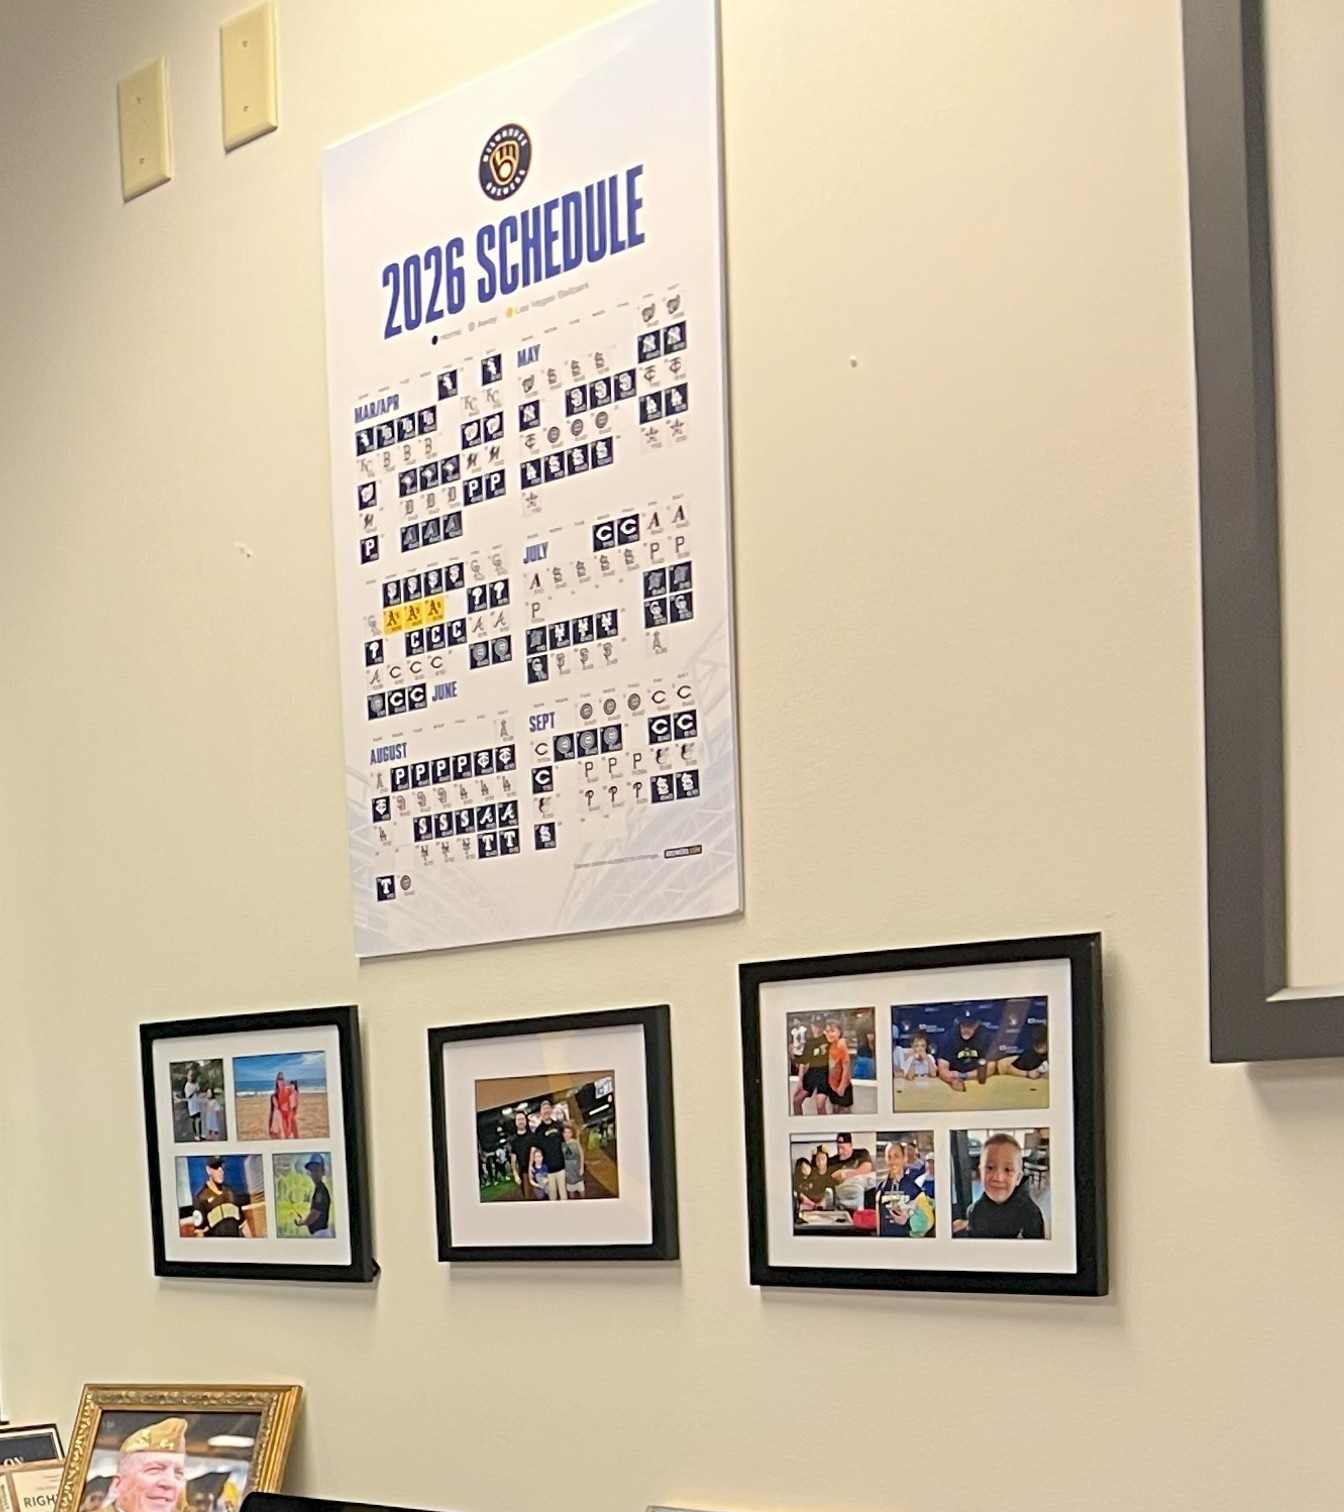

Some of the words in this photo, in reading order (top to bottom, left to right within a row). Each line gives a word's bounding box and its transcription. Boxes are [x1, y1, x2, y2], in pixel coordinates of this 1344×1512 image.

[382, 237, 465, 340] 2026
[476, 164, 646, 304] SCHEDULE
[517, 344, 541, 367] MAY
[354, 394, 400, 424] MAR/APR
[523, 542, 549, 564] JULY
[432, 681, 458, 702] JUNE
[529, 712, 556, 732] SEPT
[370, 742, 407, 765] AUGUST
[23, 1494, 59, 1508] RIGH
